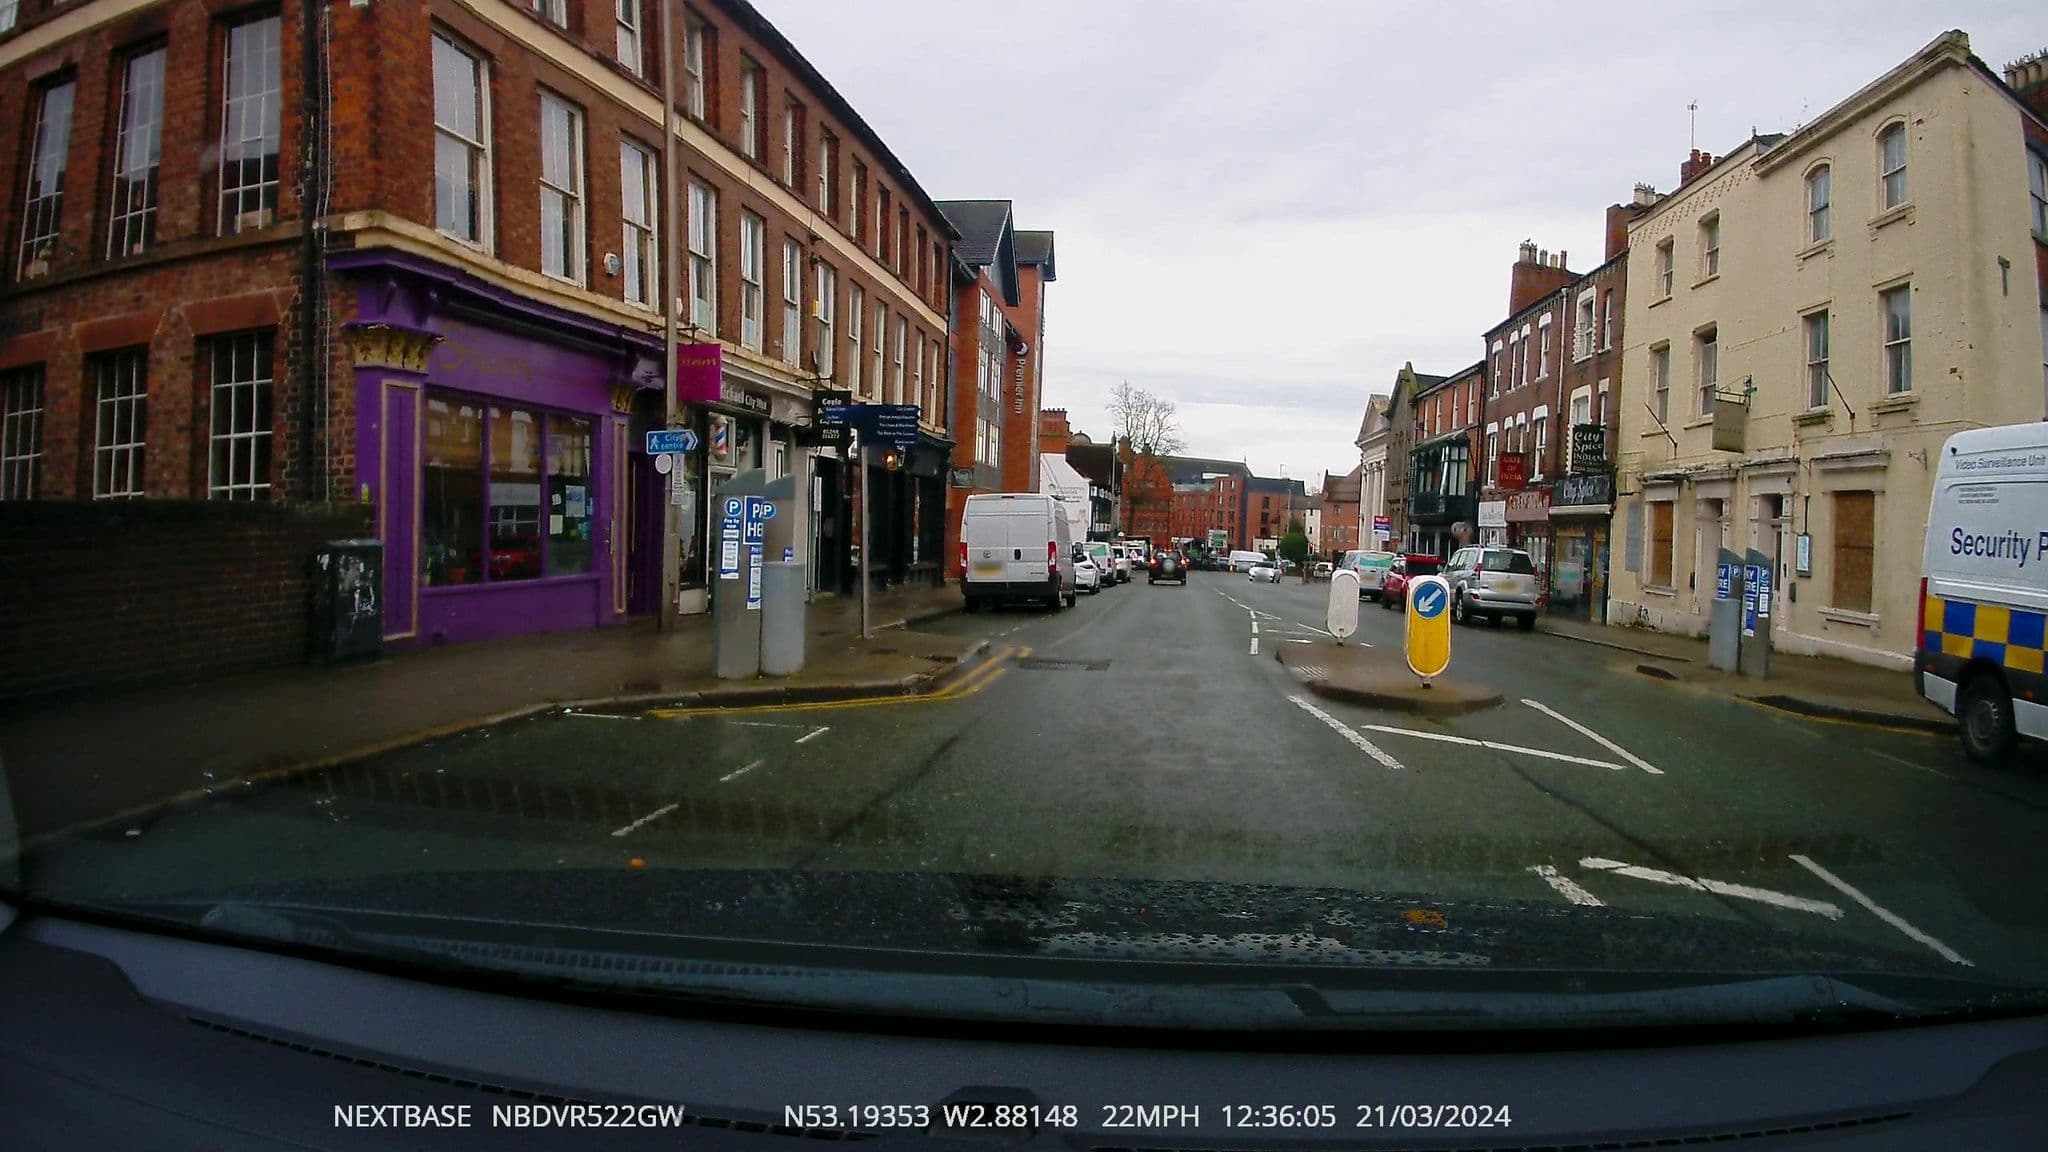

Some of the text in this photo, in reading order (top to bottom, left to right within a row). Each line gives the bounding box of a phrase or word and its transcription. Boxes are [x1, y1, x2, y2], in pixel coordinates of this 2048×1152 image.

[1014, 358, 1026, 415] Premier Inn
[665, 434, 681, 442] City
[1574, 431, 1600, 442] City
[661, 442, 684, 450] centre
[1574, 442, 1603, 453] Spice
[1956, 454, 2046, 470] Video Surveillance Unit
[1950, 527, 2048, 568] Security P
